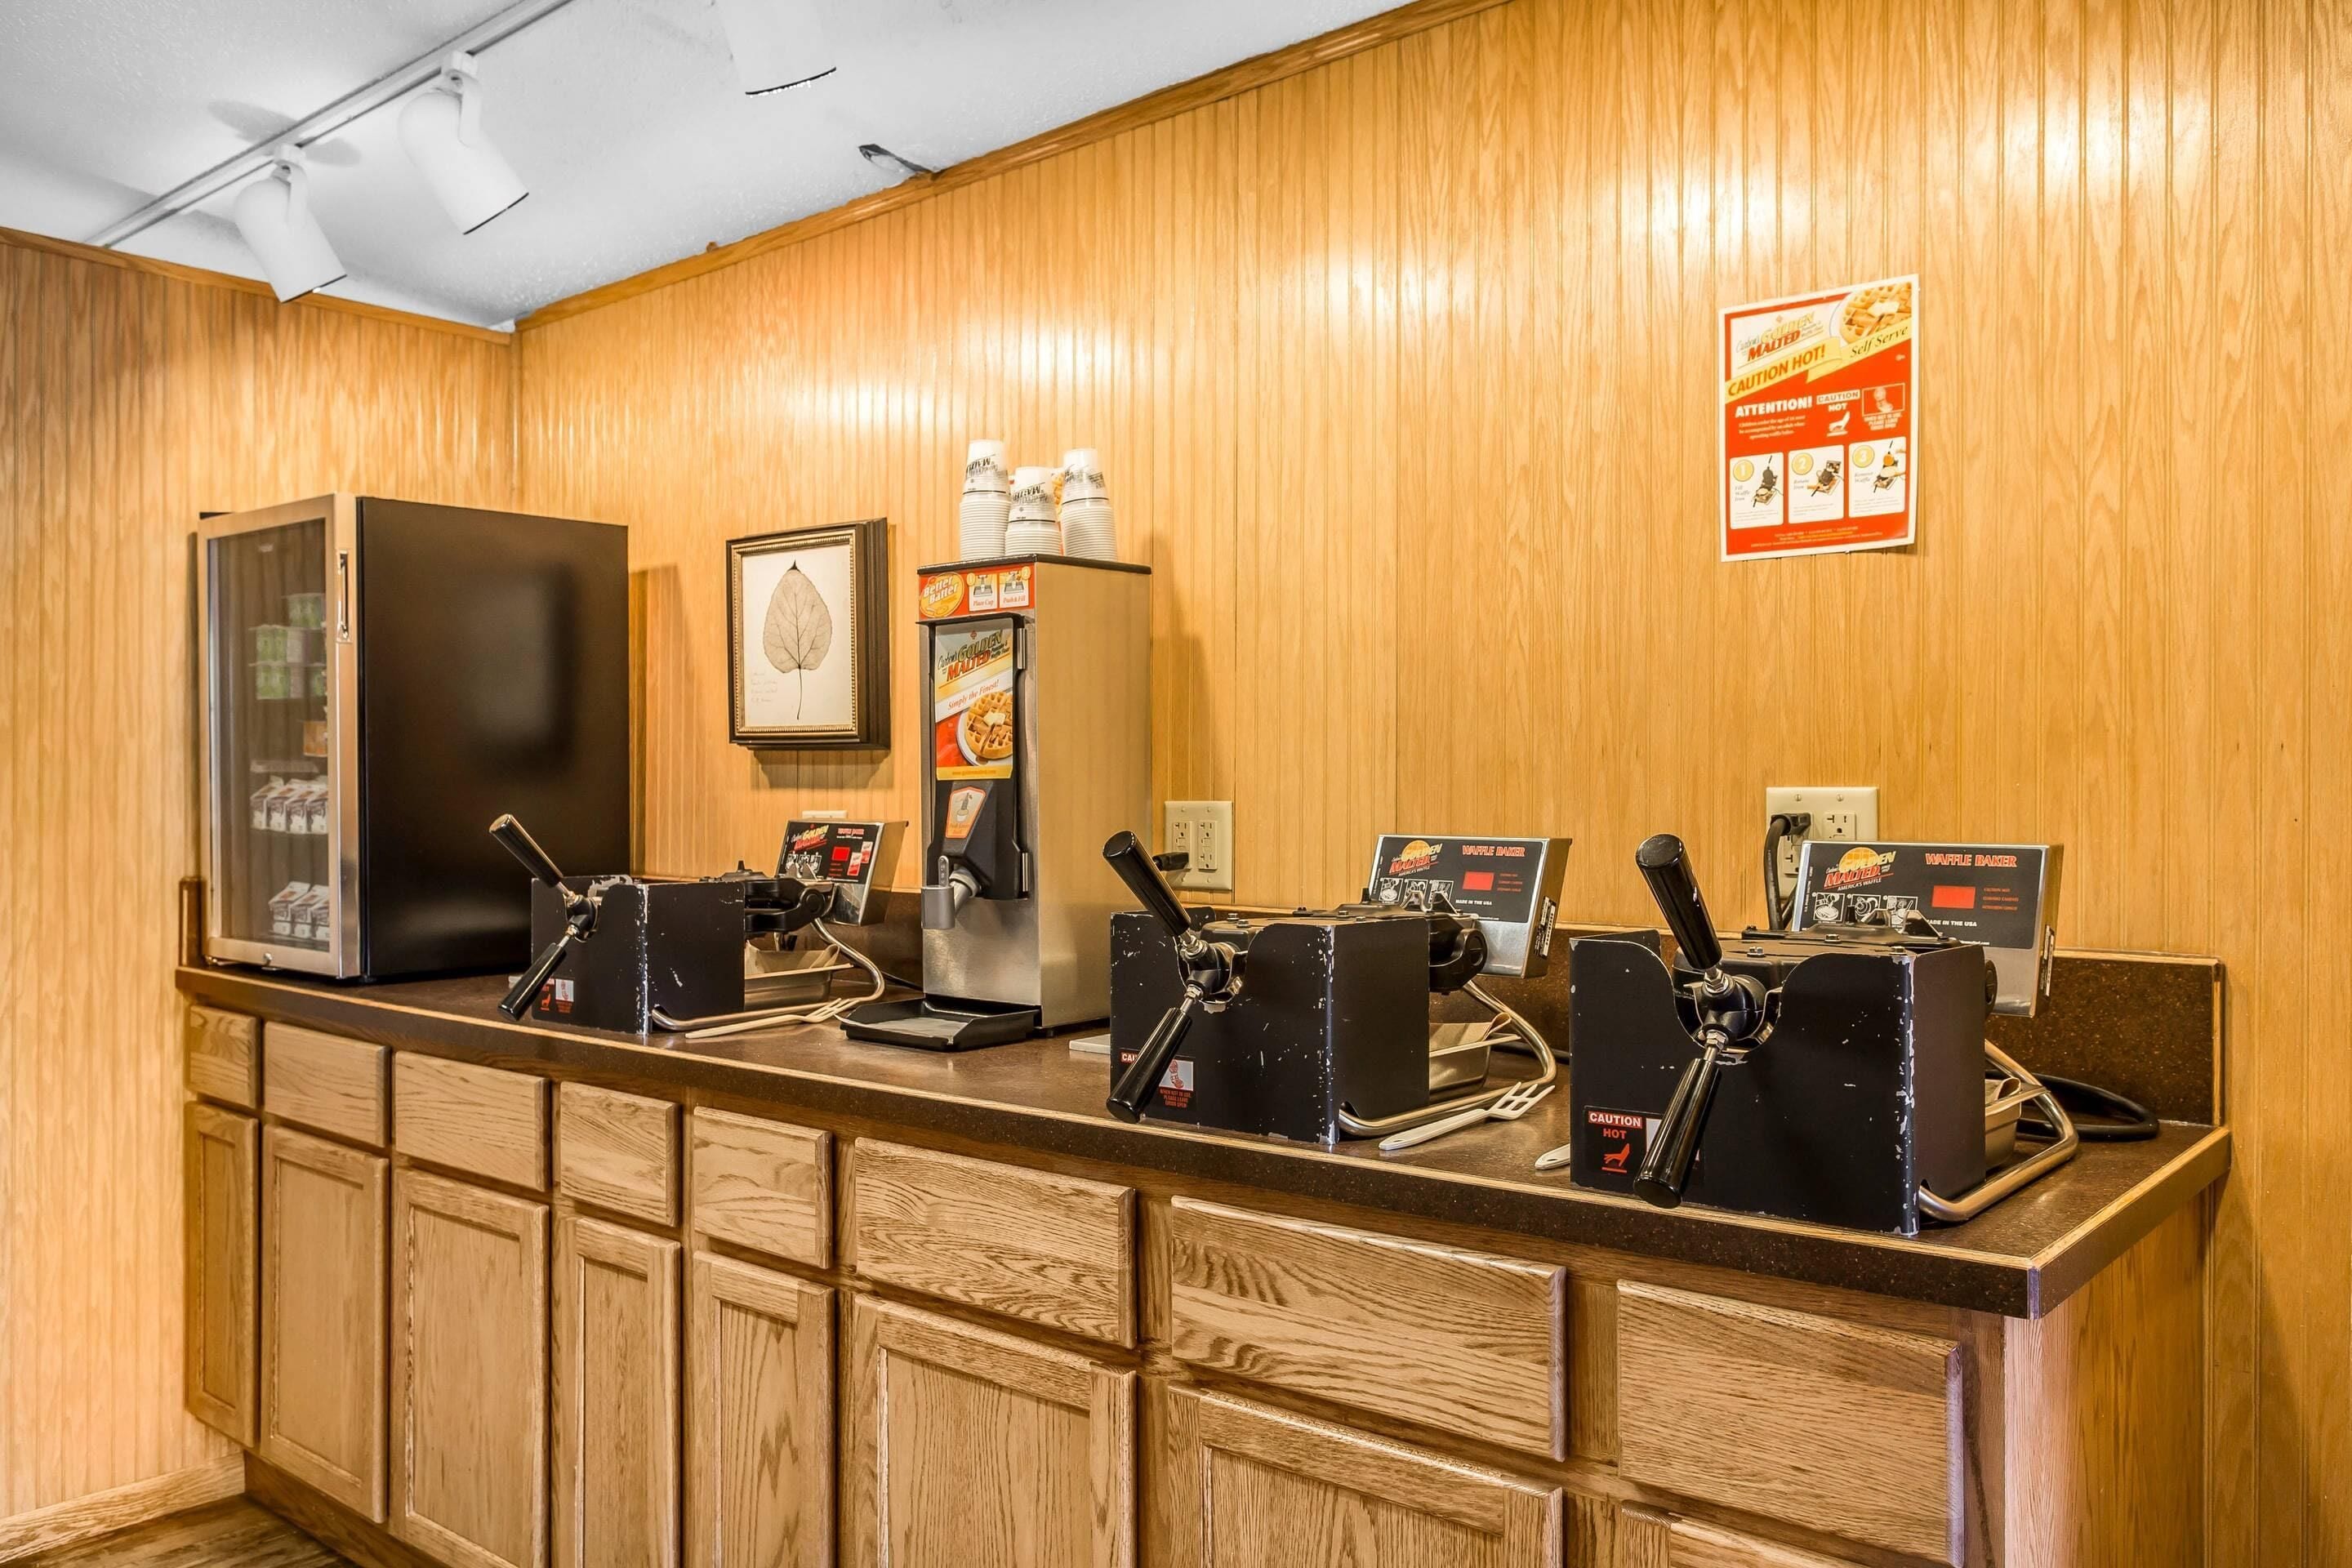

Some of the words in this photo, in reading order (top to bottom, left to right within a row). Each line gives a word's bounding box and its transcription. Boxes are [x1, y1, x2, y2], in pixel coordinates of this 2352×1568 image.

[1748, 330, 1800, 362] MALTED
[1850, 337, 1875, 358] Self
[1874, 327, 1908, 347] Serve
[1728, 360, 1789, 397] CAUTION
[1792, 344, 1825, 371] HOT!
[1735, 396, 1812, 418] ATTENTION!
[1818, 391, 1860, 403] CAUTION
[1828, 402, 1847, 412] HOT
[1799, 457, 1806, 470] 2
[923, 575, 953, 598] Better
[929, 583, 960, 604] Batter
[958, 630, 1003, 662] GOLDEN
[947, 649, 991, 682] MALTED
[948, 694, 967, 710] Simply
[969, 690, 978, 702] the
[979, 679, 1000, 696] Finest!
[1462, 845, 1495, 856] WAFFLE
[1495, 846, 1526, 858] BAKER
[1925, 853, 1972, 866] WAFFLE
[1975, 854, 2017, 867] BAKER
[1824, 865, 1881, 888] MALTED
[1838, 882, 1863, 891] AMERICA'S
[1863, 878, 1882, 887] WAFFLE
[1589, 1113, 1642, 1127] CAUTION
[1602, 1129, 1627, 1139] HOT
